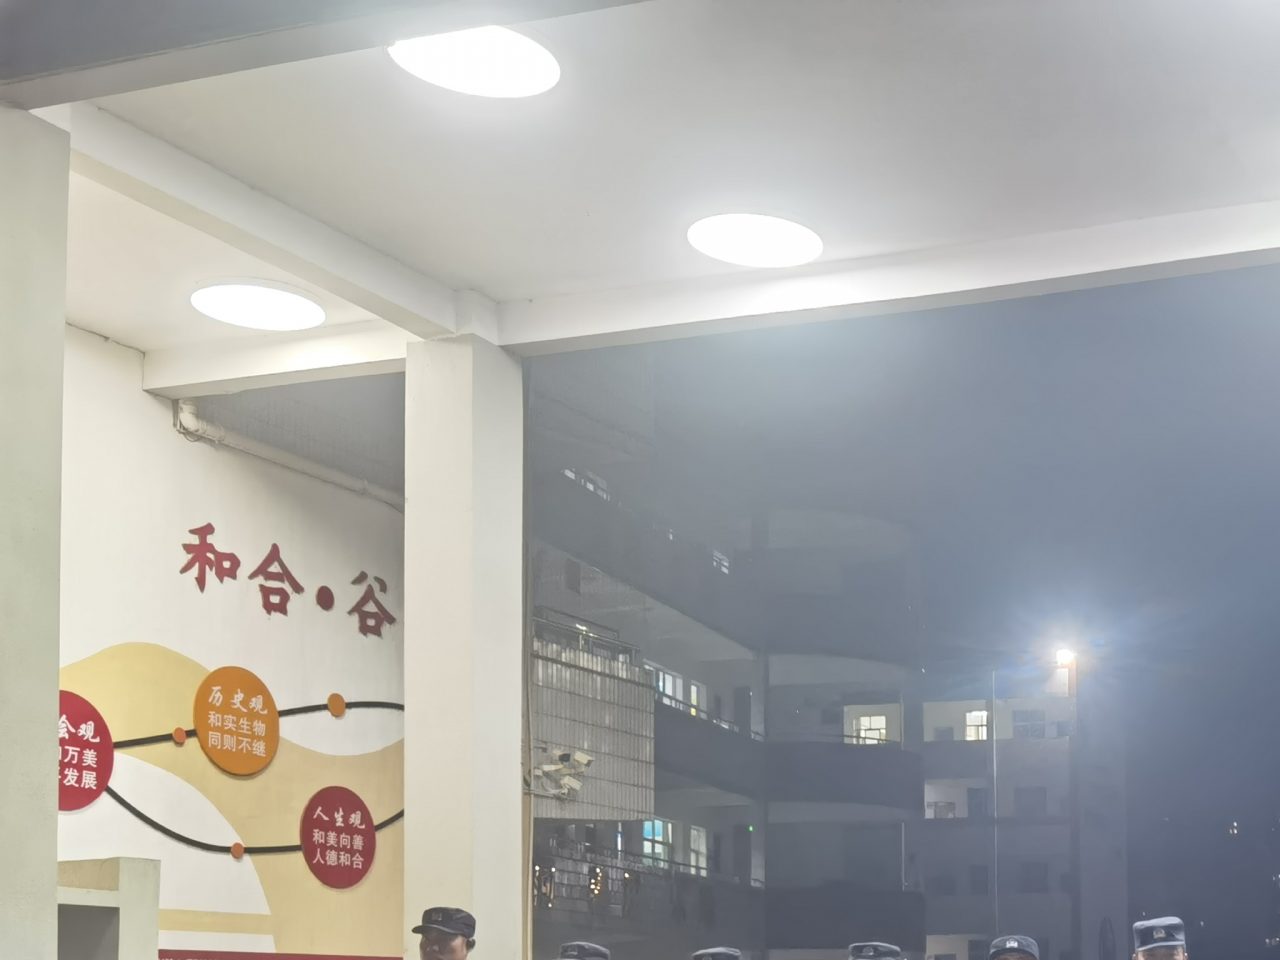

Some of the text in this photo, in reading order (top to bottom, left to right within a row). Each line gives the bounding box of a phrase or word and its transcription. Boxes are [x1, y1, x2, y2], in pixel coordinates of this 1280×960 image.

[208, 685, 268, 715] 历史观
[208, 711, 266, 737] 和实生物
[208, 731, 266, 757] 同则不继
[59, 766, 97, 790] 发展
[312, 806, 366, 830] 人生观
[312, 828, 364, 851] 和美向善
[312, 848, 364, 870] 人德和合
